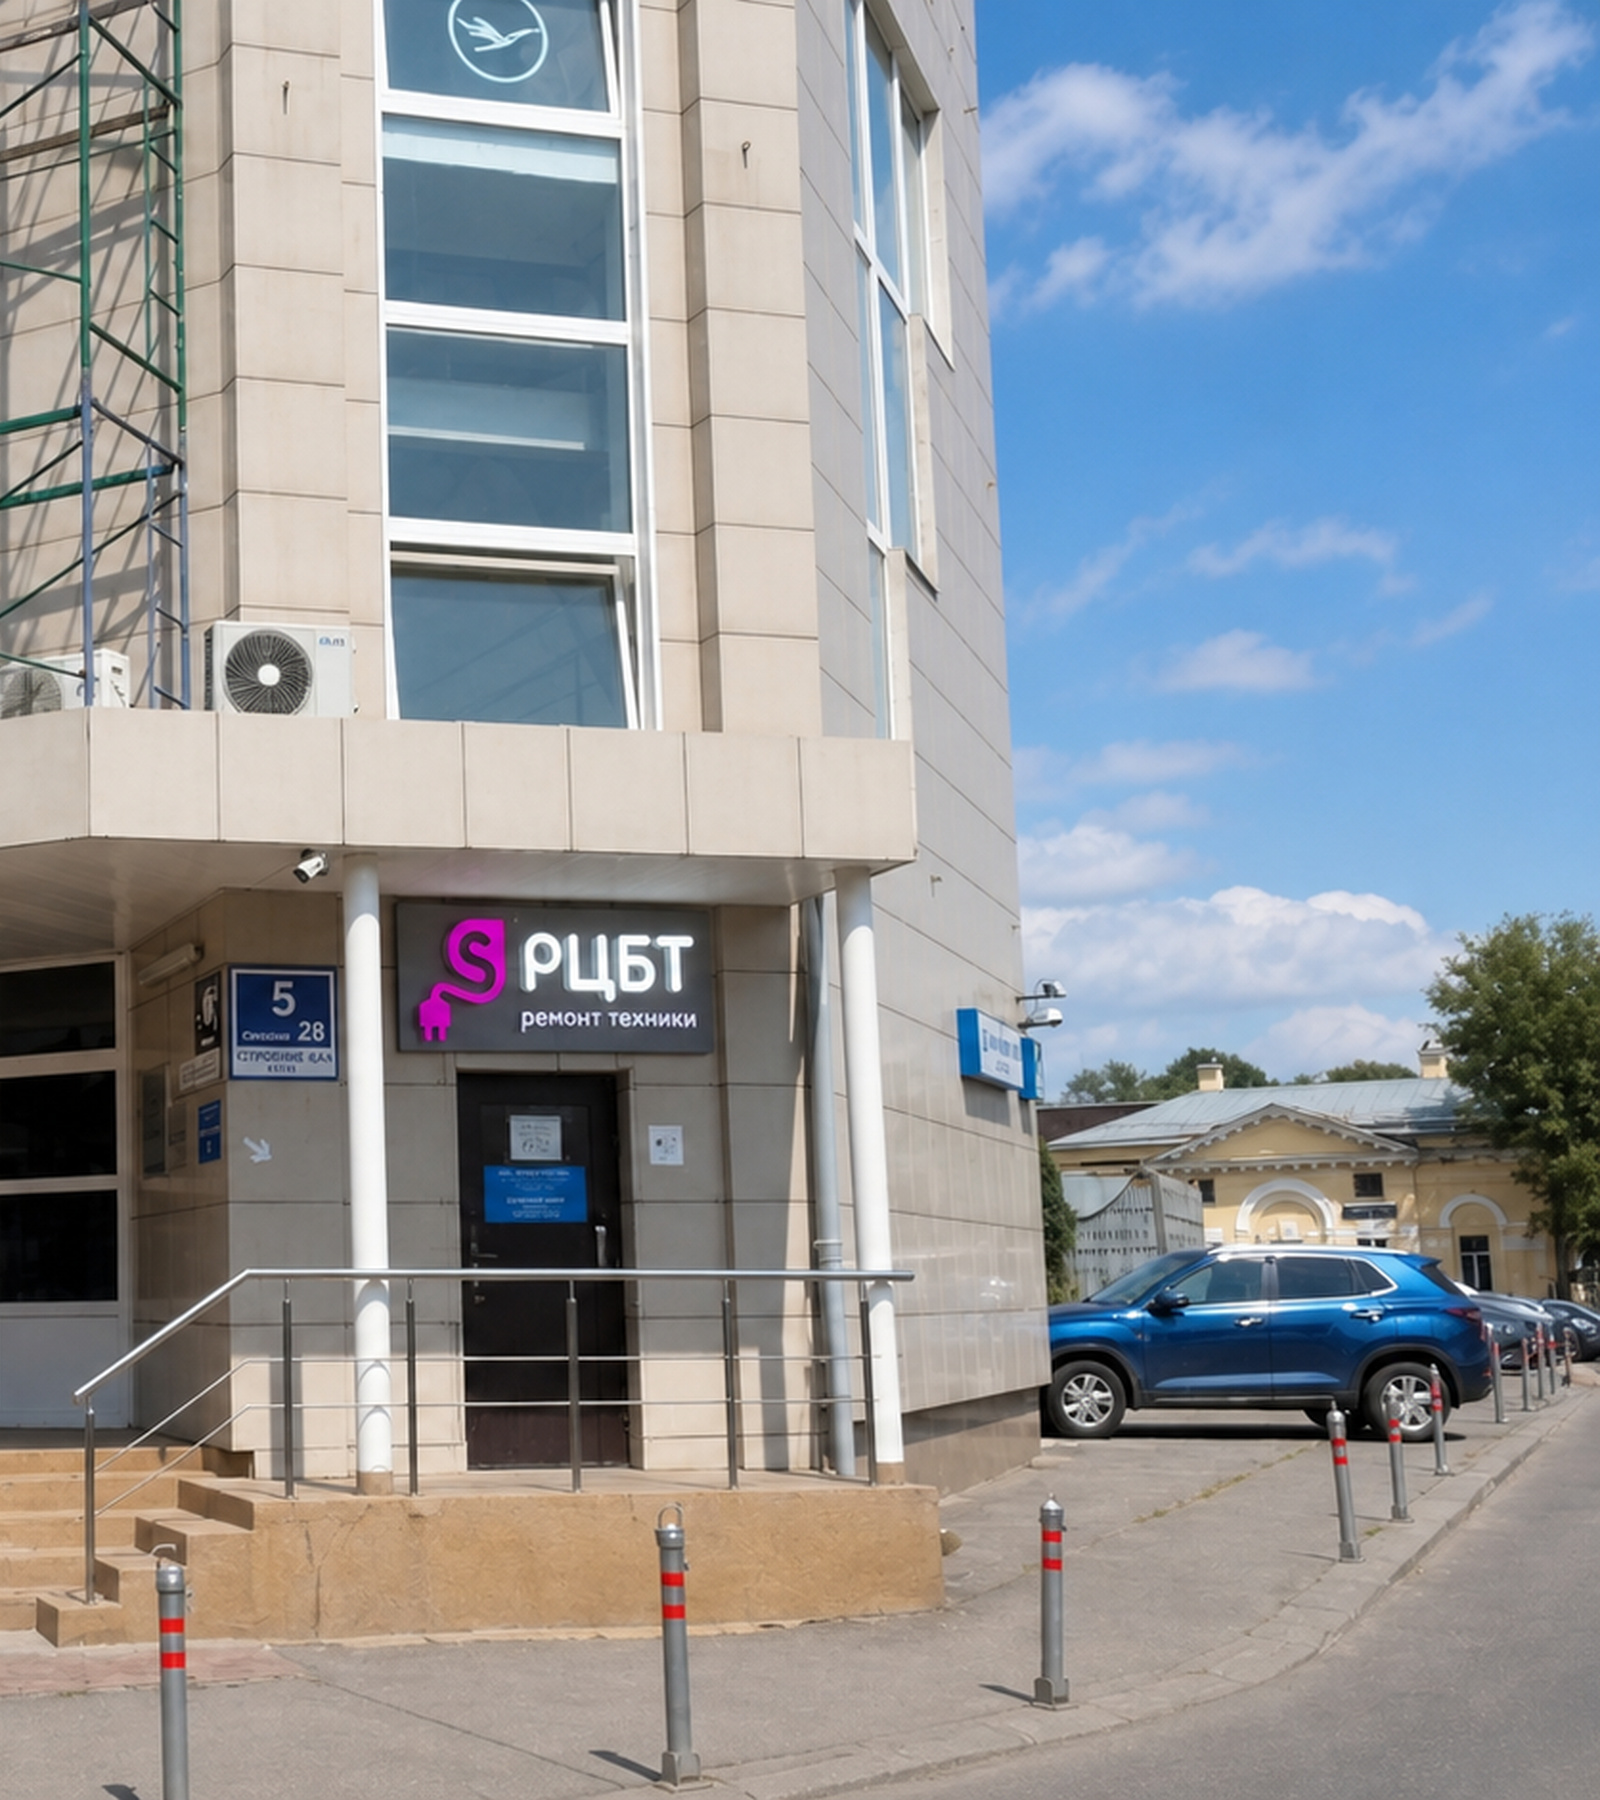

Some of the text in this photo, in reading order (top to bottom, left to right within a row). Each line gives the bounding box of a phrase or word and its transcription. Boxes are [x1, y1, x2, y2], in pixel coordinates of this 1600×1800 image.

[520, 932, 694, 1002] РЦБТ
[272, 980, 296, 1017] 5
[297, 1020, 325, 1042] 28
[521, 1010, 698, 1033] ремонт техники
